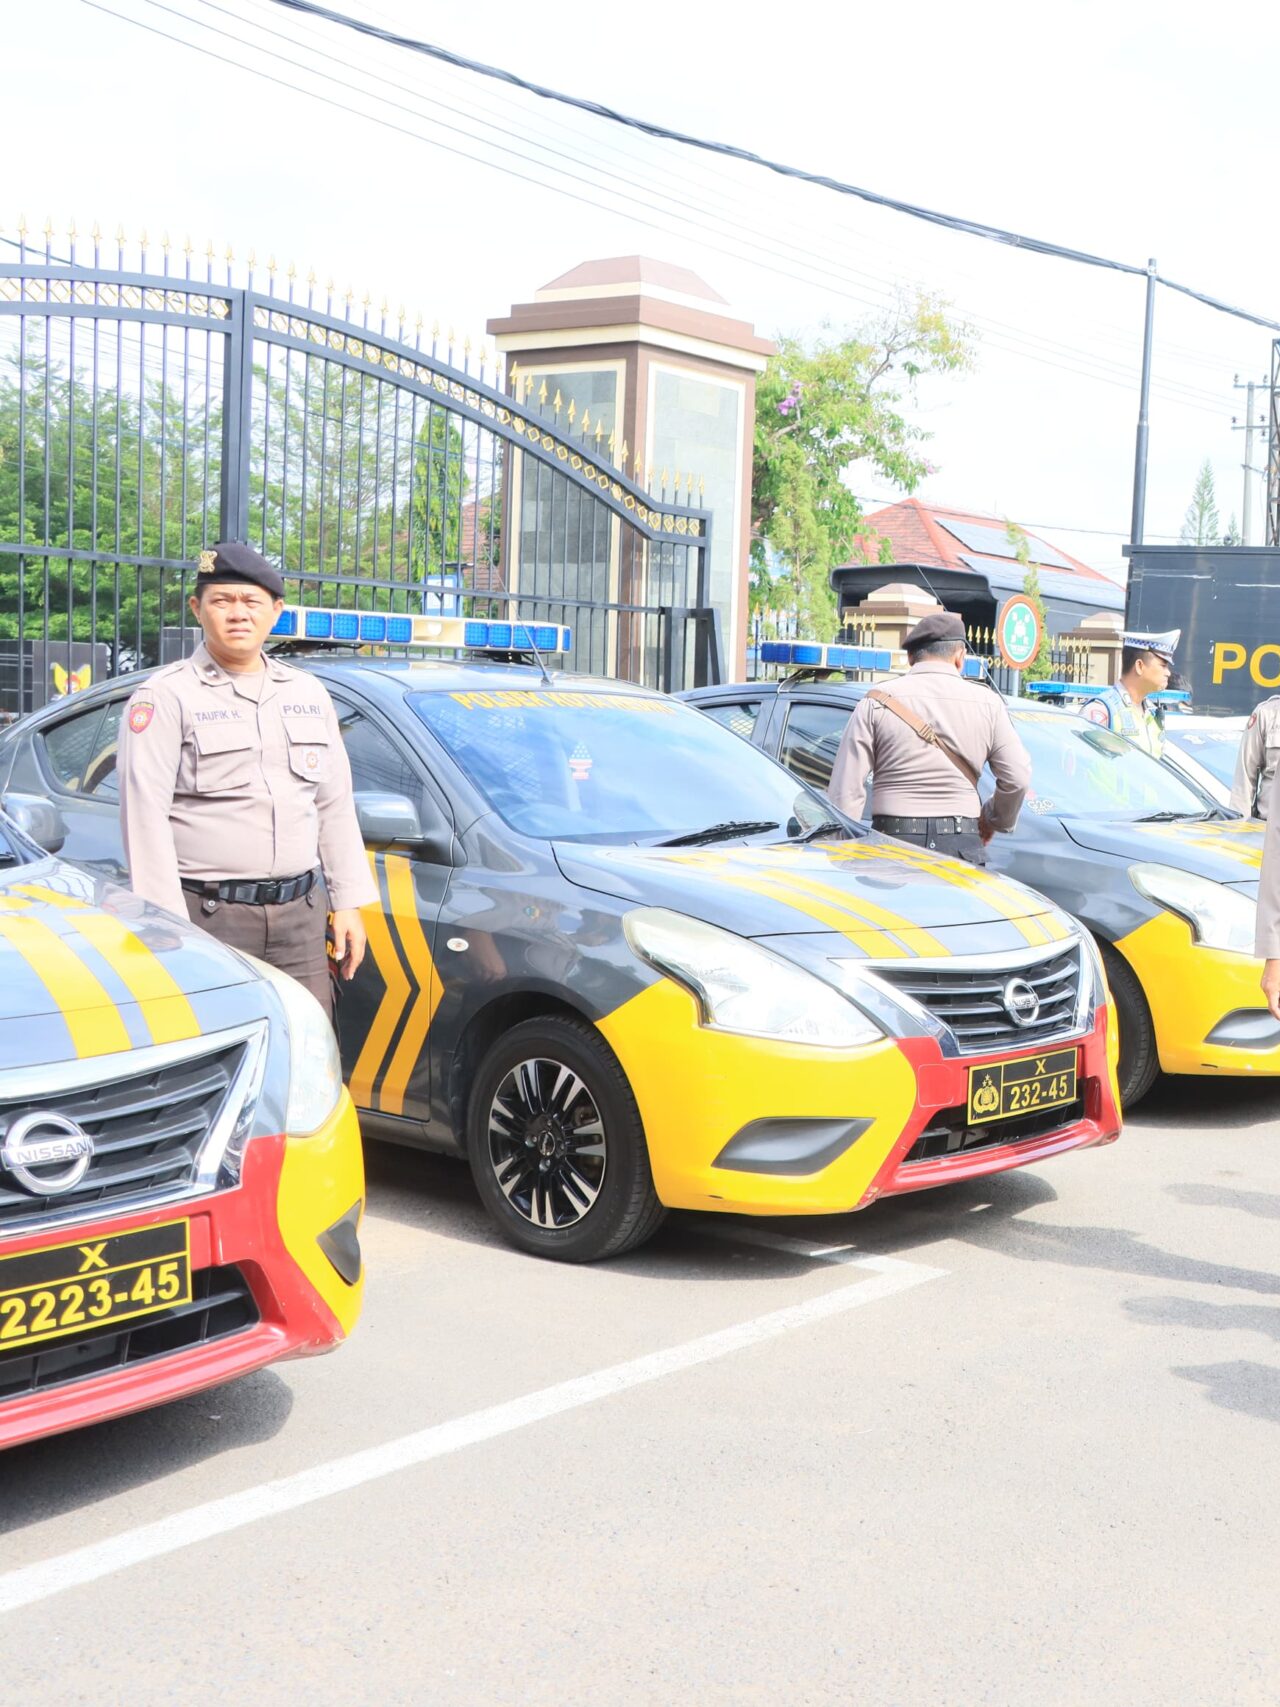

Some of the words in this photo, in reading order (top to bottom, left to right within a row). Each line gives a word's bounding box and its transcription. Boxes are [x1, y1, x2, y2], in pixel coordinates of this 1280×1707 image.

[282, 704, 321, 715] POLRI
[448, 690, 554, 711] POLSEK
[195, 710, 229, 722] TAUFIK
[1034, 1058, 1047, 1076] X
[1009, 1075, 1068, 1110] 232-45
[16, 1141, 88, 1164] NISSAN
[78, 1241, 109, 1273] X
[0, 1261, 180, 1339] 2223-45
